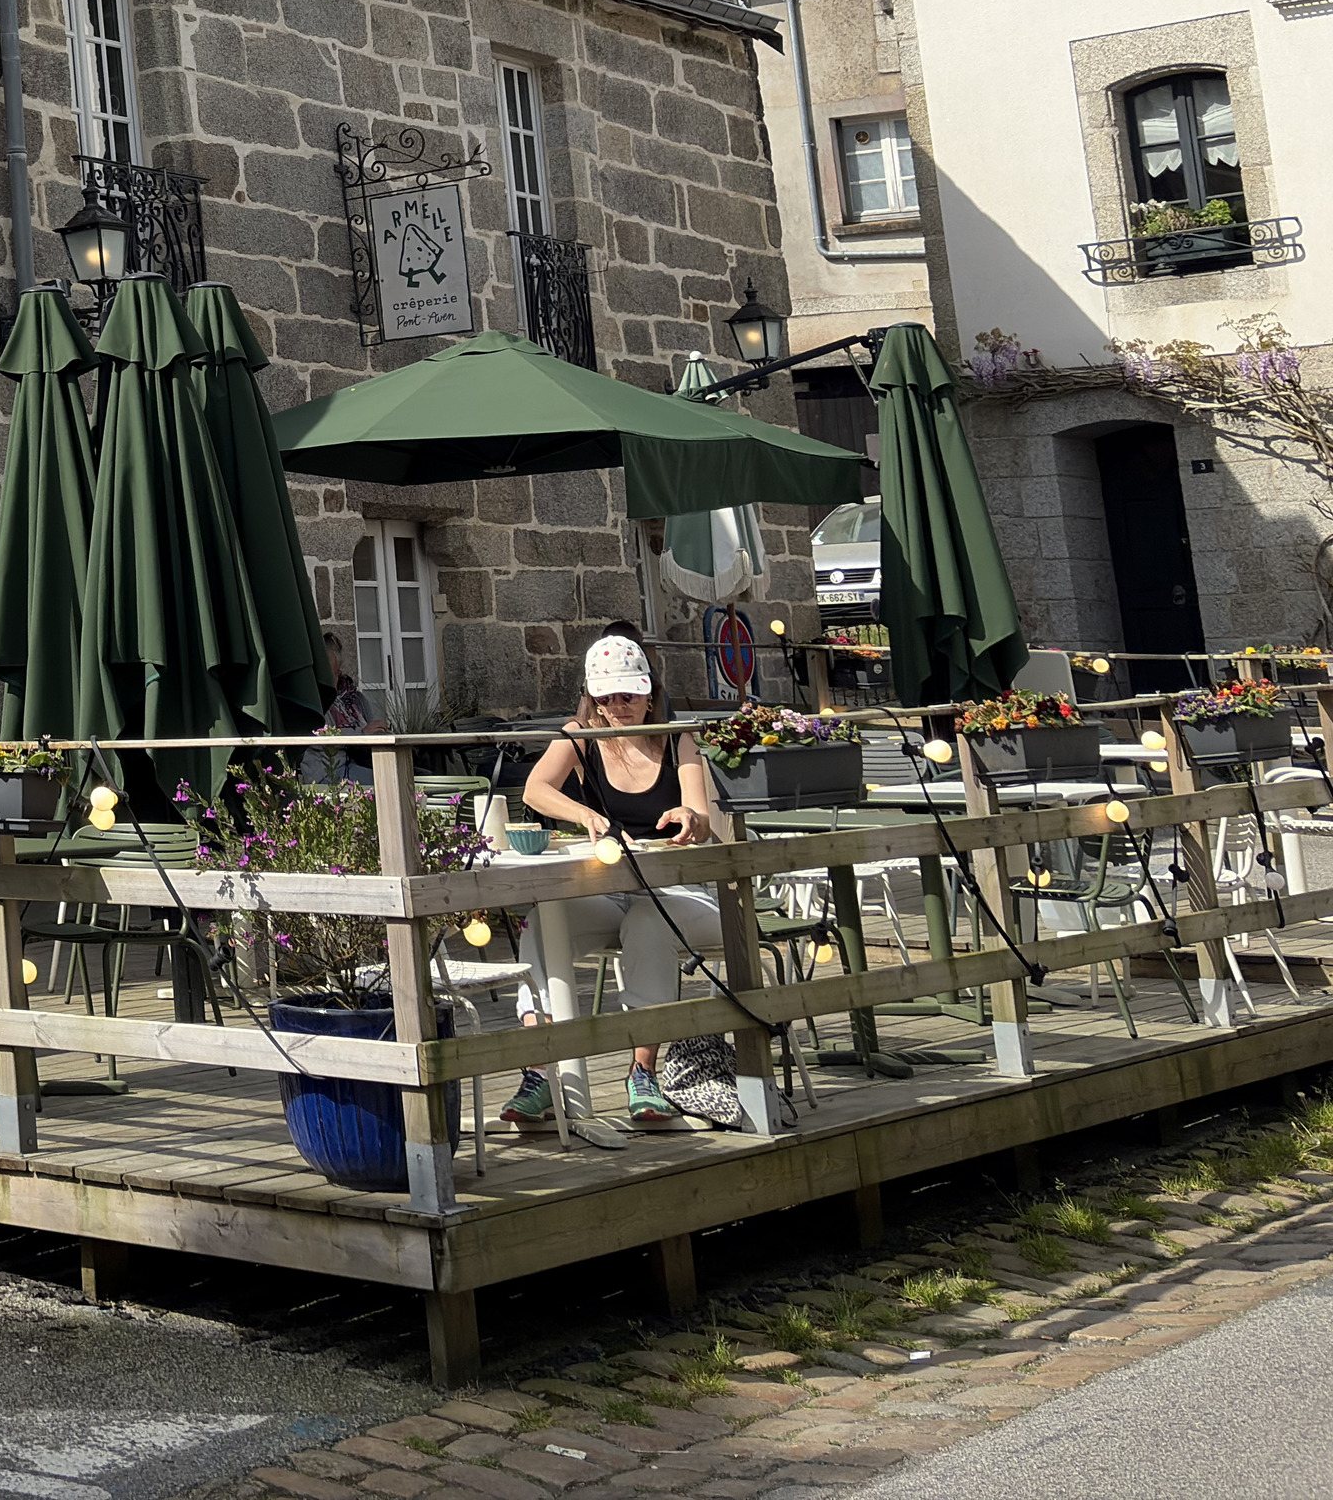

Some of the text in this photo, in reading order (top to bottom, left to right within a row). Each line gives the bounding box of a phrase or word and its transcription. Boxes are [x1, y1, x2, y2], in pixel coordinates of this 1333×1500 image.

[383, 200, 454, 245] ARMELLE
[392, 293, 458, 311] crêperie
[396, 311, 457, 331] Pont-Aven
[1199, 462, 1206, 471] 3
